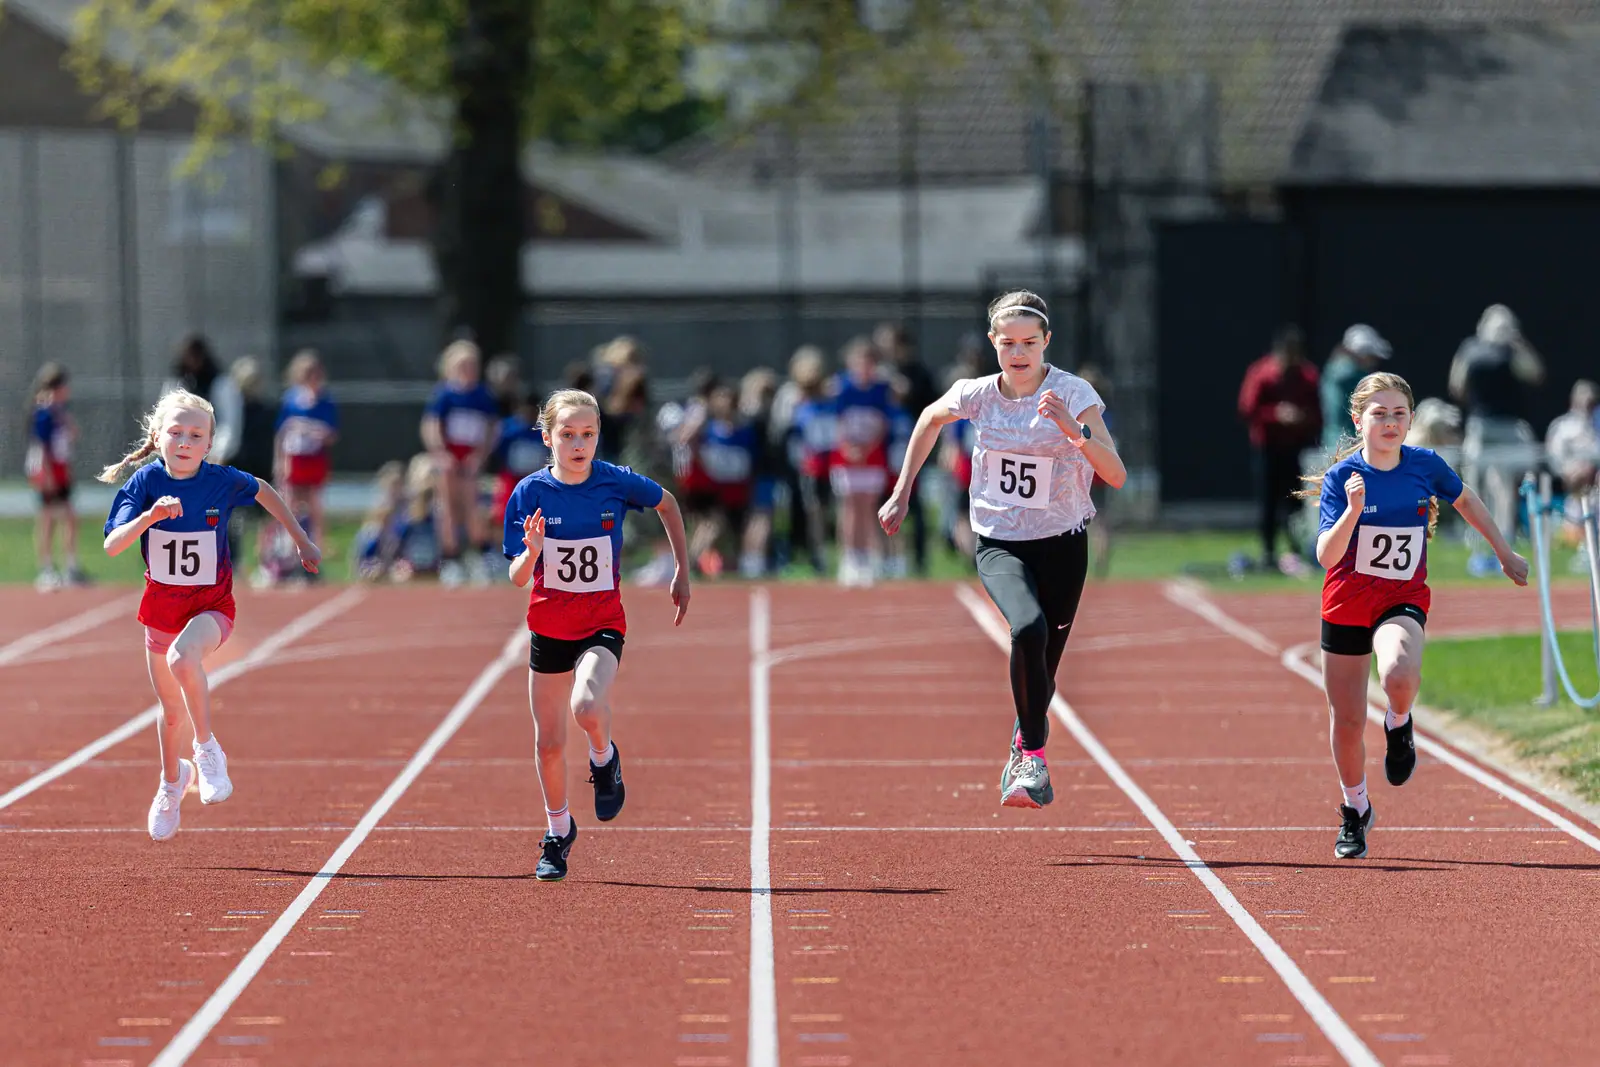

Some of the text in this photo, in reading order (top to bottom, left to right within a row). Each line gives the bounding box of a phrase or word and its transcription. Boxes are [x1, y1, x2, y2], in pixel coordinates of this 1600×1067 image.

[1000, 458, 1037, 499] 55
[544, 517, 562, 525] -CLUB
[162, 539, 200, 577] 15
[557, 545, 599, 583] 38
[1370, 533, 1412, 571] 23
